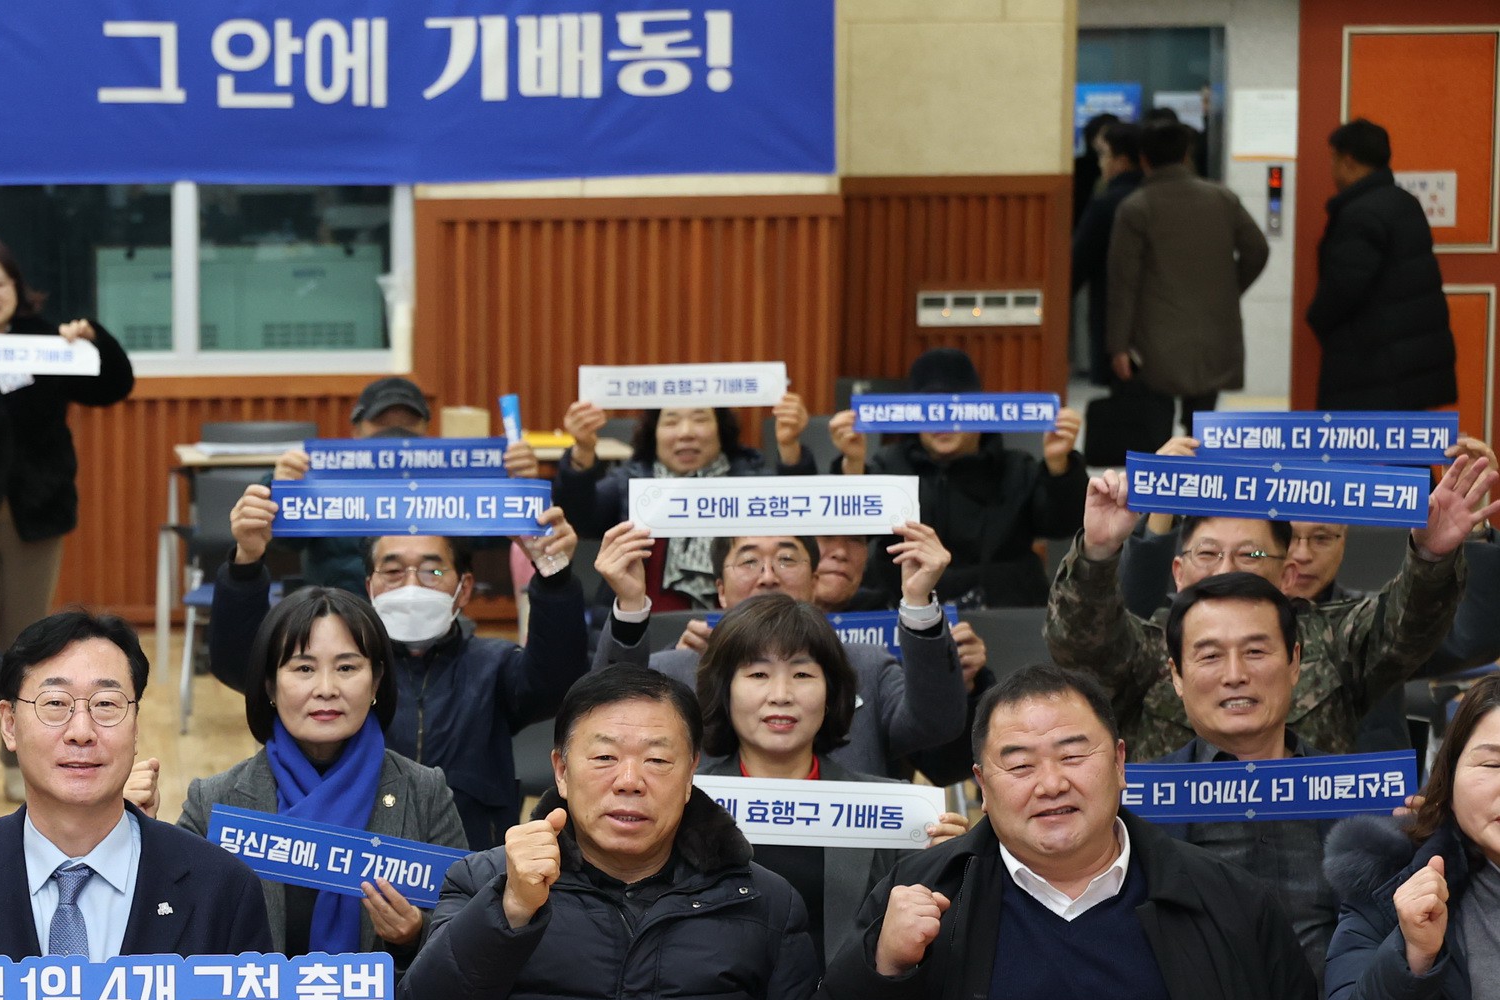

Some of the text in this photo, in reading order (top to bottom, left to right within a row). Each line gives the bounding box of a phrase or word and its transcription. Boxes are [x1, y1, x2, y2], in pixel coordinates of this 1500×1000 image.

[98, 9, 735, 108] 그 안에 기배동!
[608, 379, 758, 396] 그 안에 효행구 기배동
[859, 404, 1053, 422] 당신곁에, 더 가까이, 더 크게
[1202, 426, 1448, 449] 당신곁에, 더 가까이, 더 크게
[310, 450, 501, 470] 당신곁에, 더 가까이, 더 크게
[1134, 471, 1417, 509] 당신곁에, 더 가까이, 더 크게
[283, 496, 542, 520] 당신곁에, 더 가까이, 더 크게
[668, 496, 882, 518] 그 안에 효행구 기배동
[1154, 783, 1175, 804] 더
[1184, 780, 1262, 804] 가까이,
[1272, 778, 1293, 801] 더
[1303, 772, 1404, 800] 당신곁에,
[746, 800, 820, 825] 효행구
[831, 804, 903, 829] 기배동
[219, 826, 434, 891] 당신곁에, 더 가까이,
